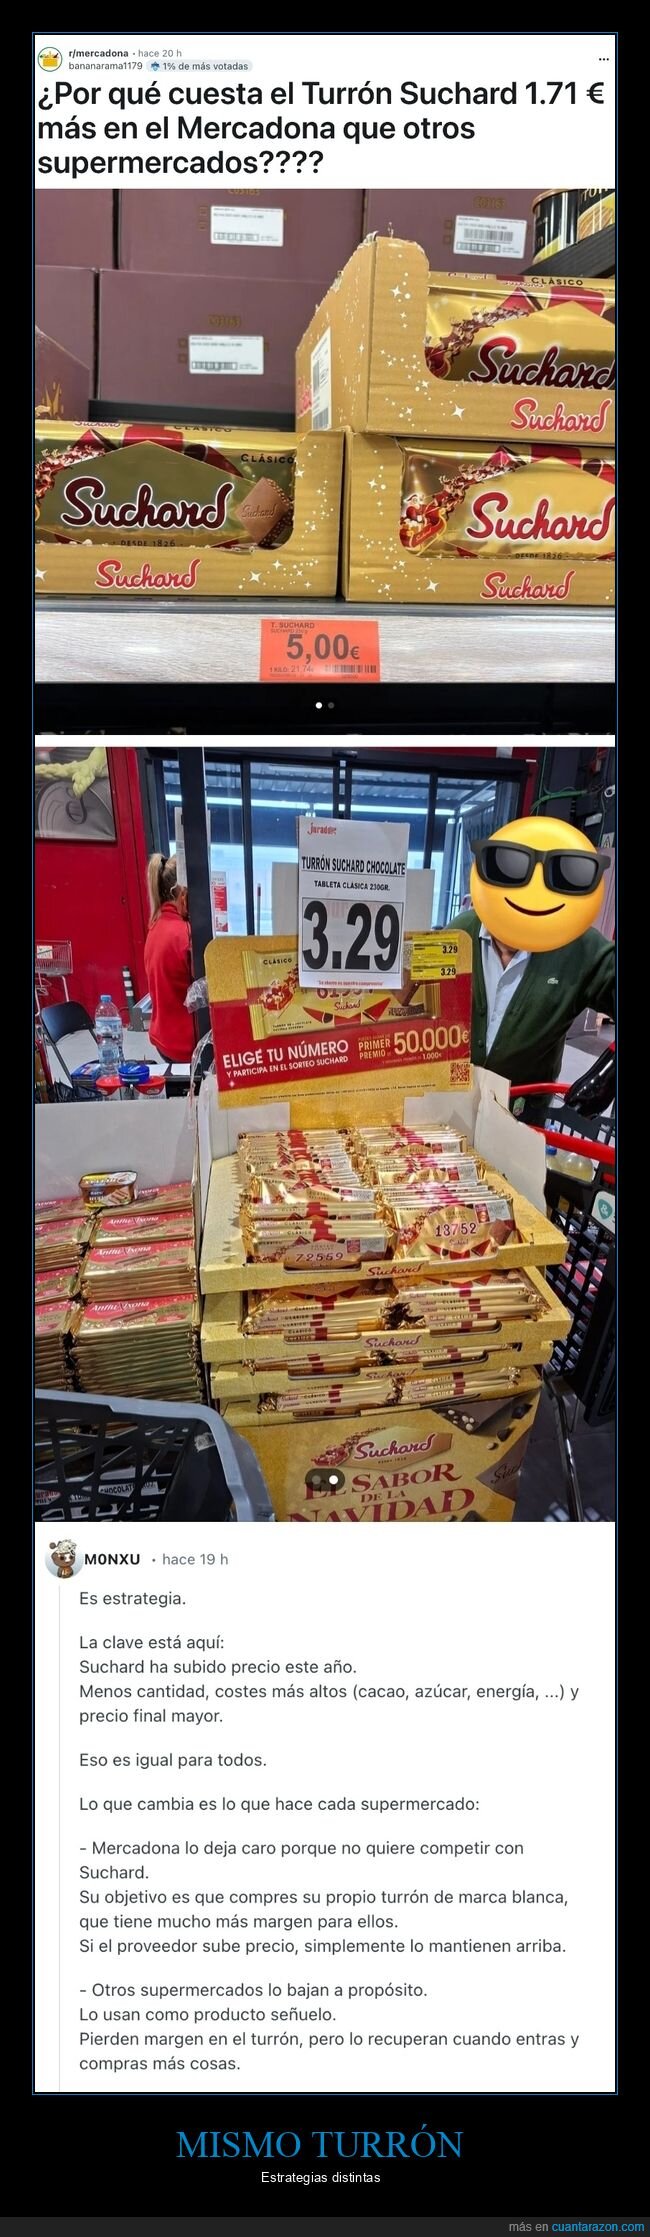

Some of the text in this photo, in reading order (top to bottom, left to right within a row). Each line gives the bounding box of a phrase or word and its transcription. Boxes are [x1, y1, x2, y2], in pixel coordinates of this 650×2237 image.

[510, 397, 612, 433] Suchard
[61, 476, 235, 530] Suchard
[466, 491, 616, 542] Suchard
[95, 558, 201, 590] Suchard
[480, 570, 576, 600] Suchard
[302, 855, 406, 876] TURRÓN SUCHARD CHOCOLATE
[314, 881, 341, 889] TABLETA
[302, 900, 400, 972] 3.29
[442, 946, 458, 954] 3.29
[441, 968, 456, 976] 3.29
[334, 1000, 361, 1011] Suchard
[267, 1048, 284, 1062] TU
[288, 1040, 349, 1059] NÚMERO
[358, 1039, 391, 1051] PRIMER
[359, 1050, 386, 1060] PREMIO
[226, 1071, 233, 1079] Y
[233, 1067, 268, 1078] PARTICIPA
[289, 1060, 315, 1069] SORTEO
[317, 1056, 349, 1066] SUCHARD
[435, 1223, 477, 1237] 13752
[295, 1252, 344, 1262] 72559
[366, 1262, 424, 1277] Suchard
[363, 1335, 423, 1349] Suchard
[353, 1433, 436, 1460] Suchard
[351, 1463, 462, 1493] SABOR
[361, 1490, 406, 1503] DE LA
